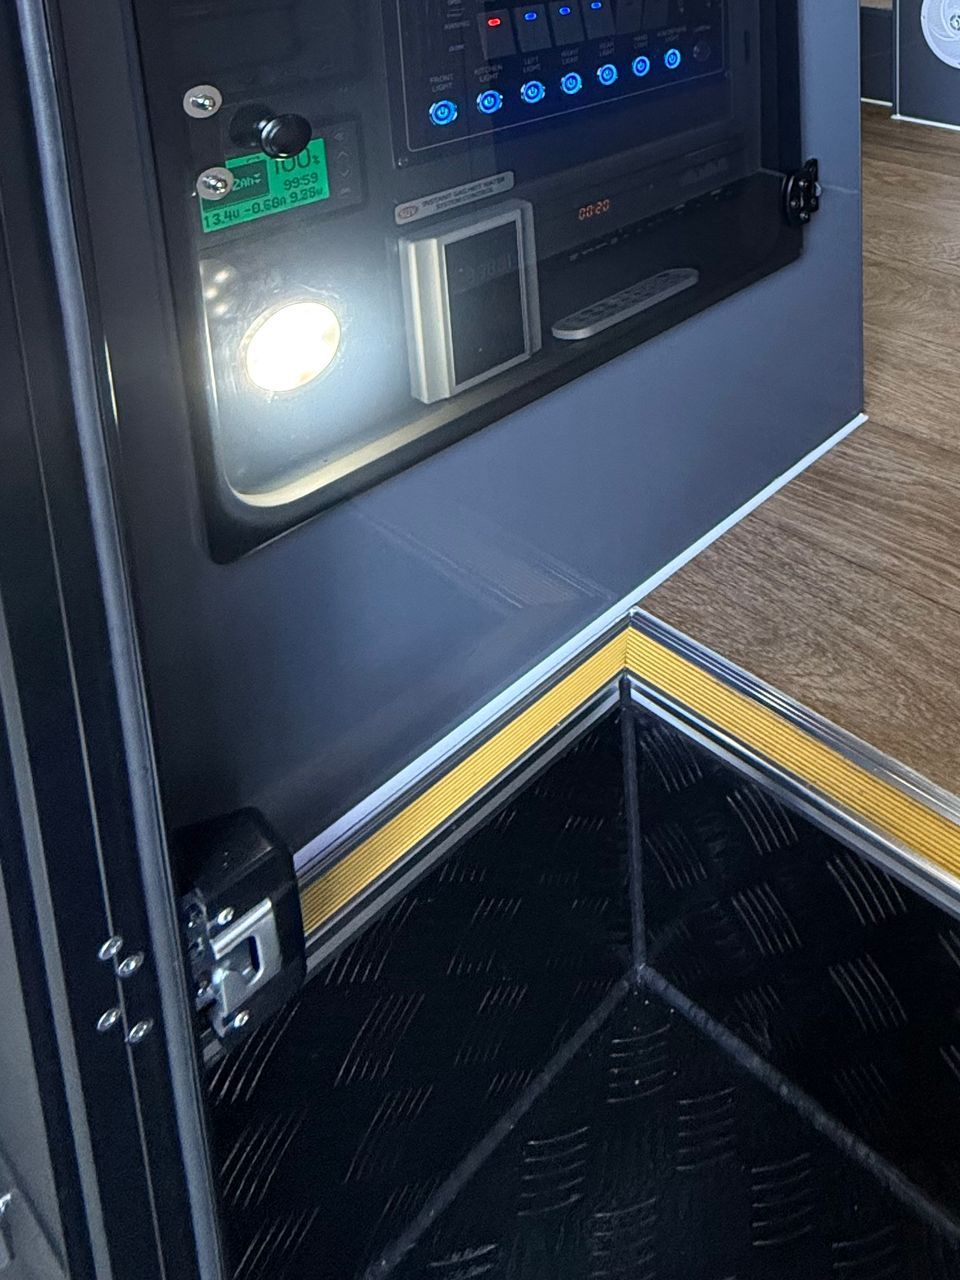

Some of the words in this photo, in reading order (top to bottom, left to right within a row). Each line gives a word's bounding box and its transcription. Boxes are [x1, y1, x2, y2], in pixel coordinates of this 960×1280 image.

[473, 63, 504, 76] KITCHEN
[429, 72, 454, 84] FRONT
[431, 81, 453, 94] LIGHT
